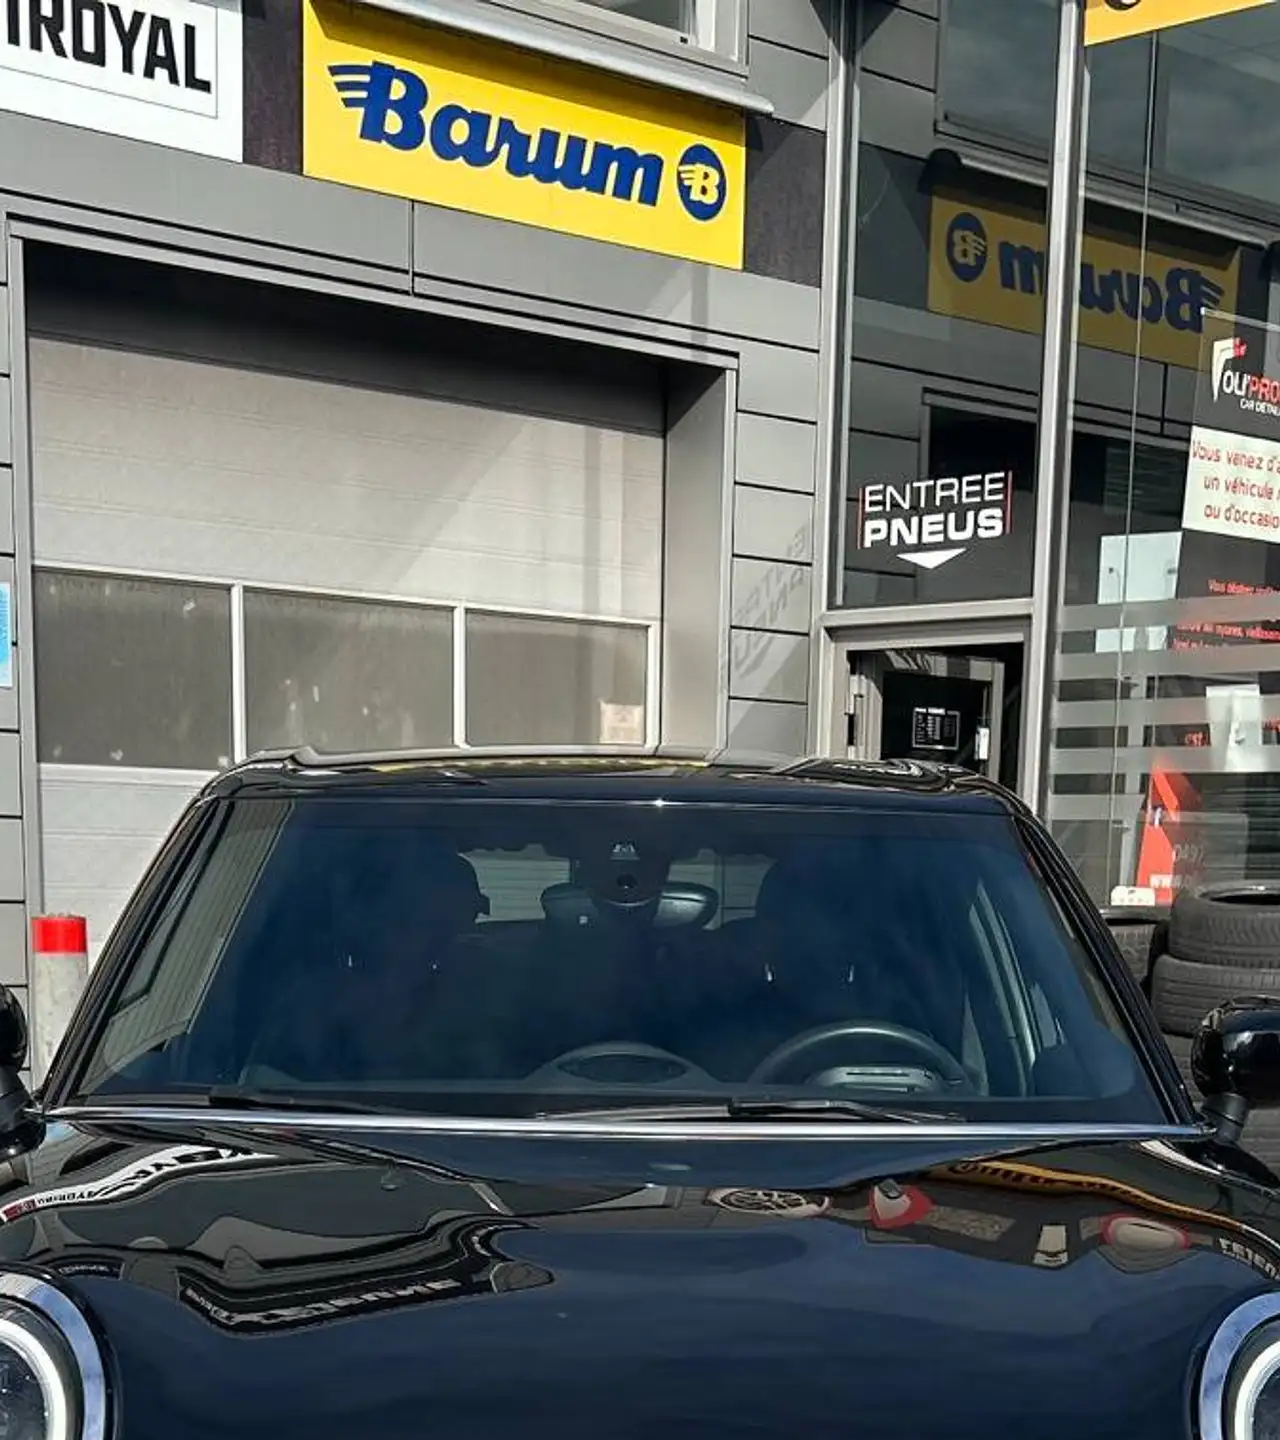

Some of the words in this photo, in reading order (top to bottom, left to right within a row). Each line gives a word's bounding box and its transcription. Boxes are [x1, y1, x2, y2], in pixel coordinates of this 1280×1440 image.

[328, 60, 664, 207] Barum
[1192, 440, 1221, 462] Vous
[865, 472, 1005, 513] ENTREE
[1203, 476, 1220, 491] un
[1224, 475, 1274, 500] véhicule
[864, 507, 1004, 548] PNEUS
[1203, 503, 1221, 519] ou
